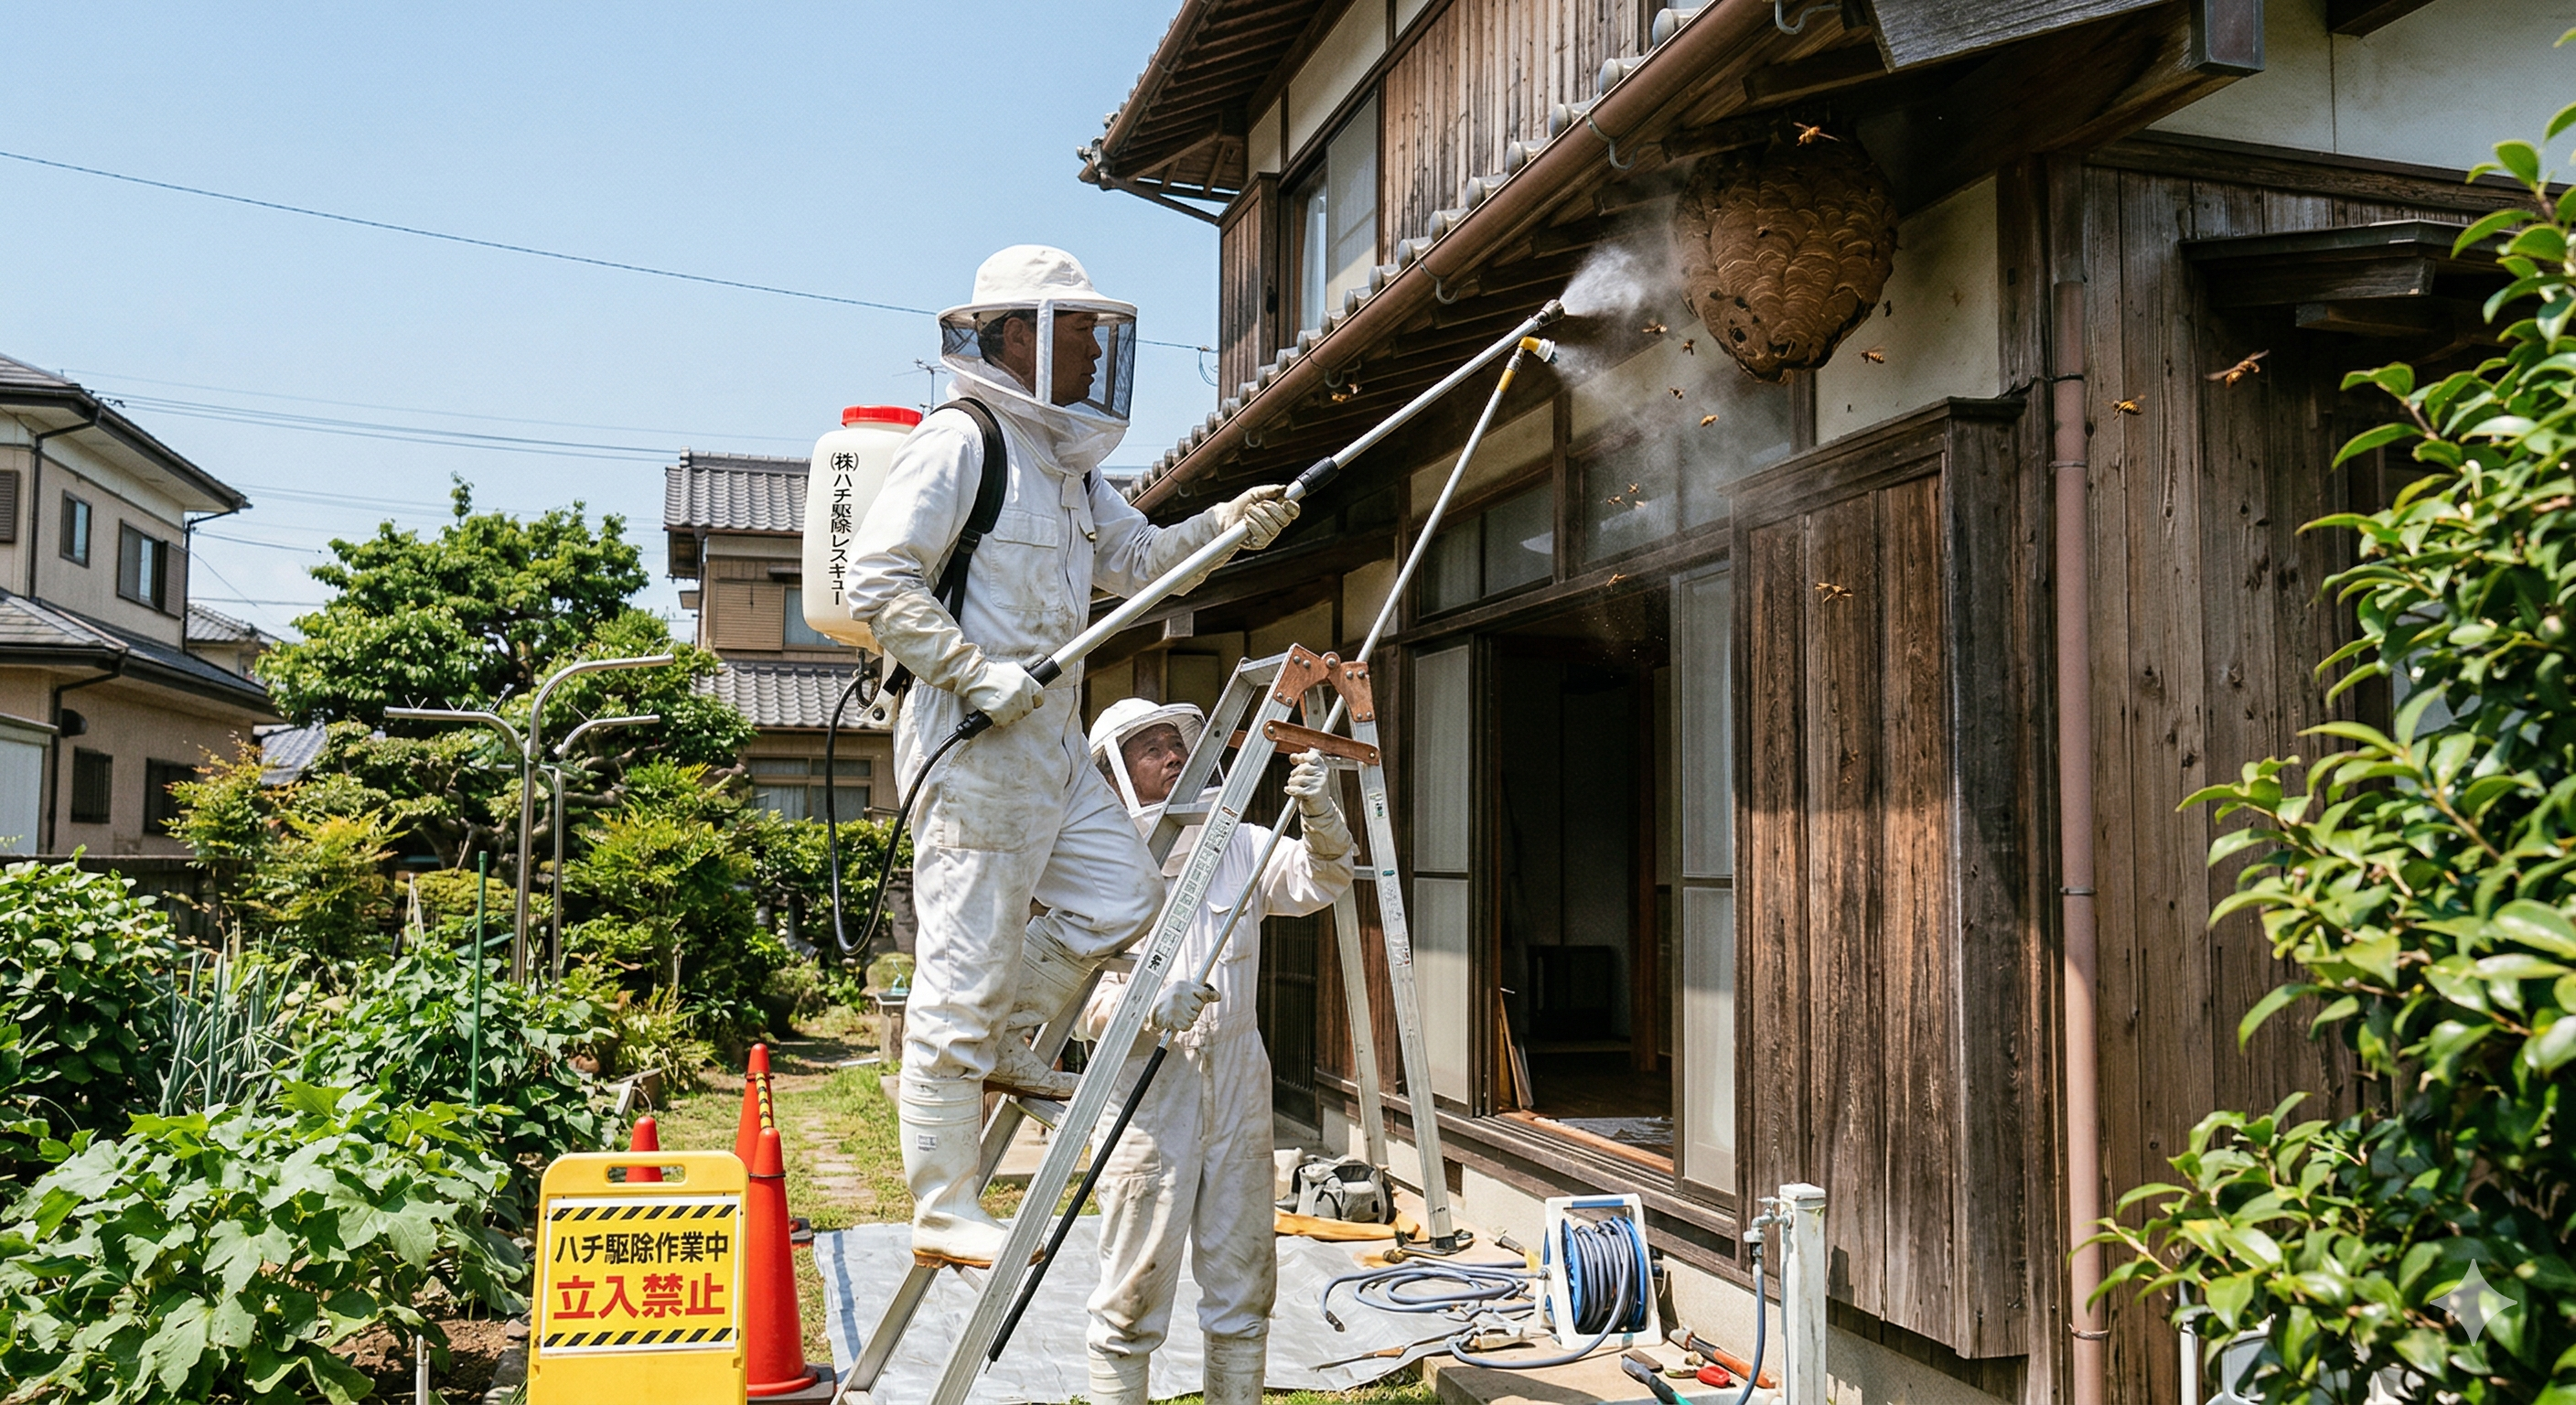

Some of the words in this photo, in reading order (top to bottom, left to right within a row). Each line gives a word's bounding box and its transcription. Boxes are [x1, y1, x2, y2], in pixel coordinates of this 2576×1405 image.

[554, 1230, 729, 1265] ハチ駆除作業中
[553, 1272, 725, 1320] 立入禁止
